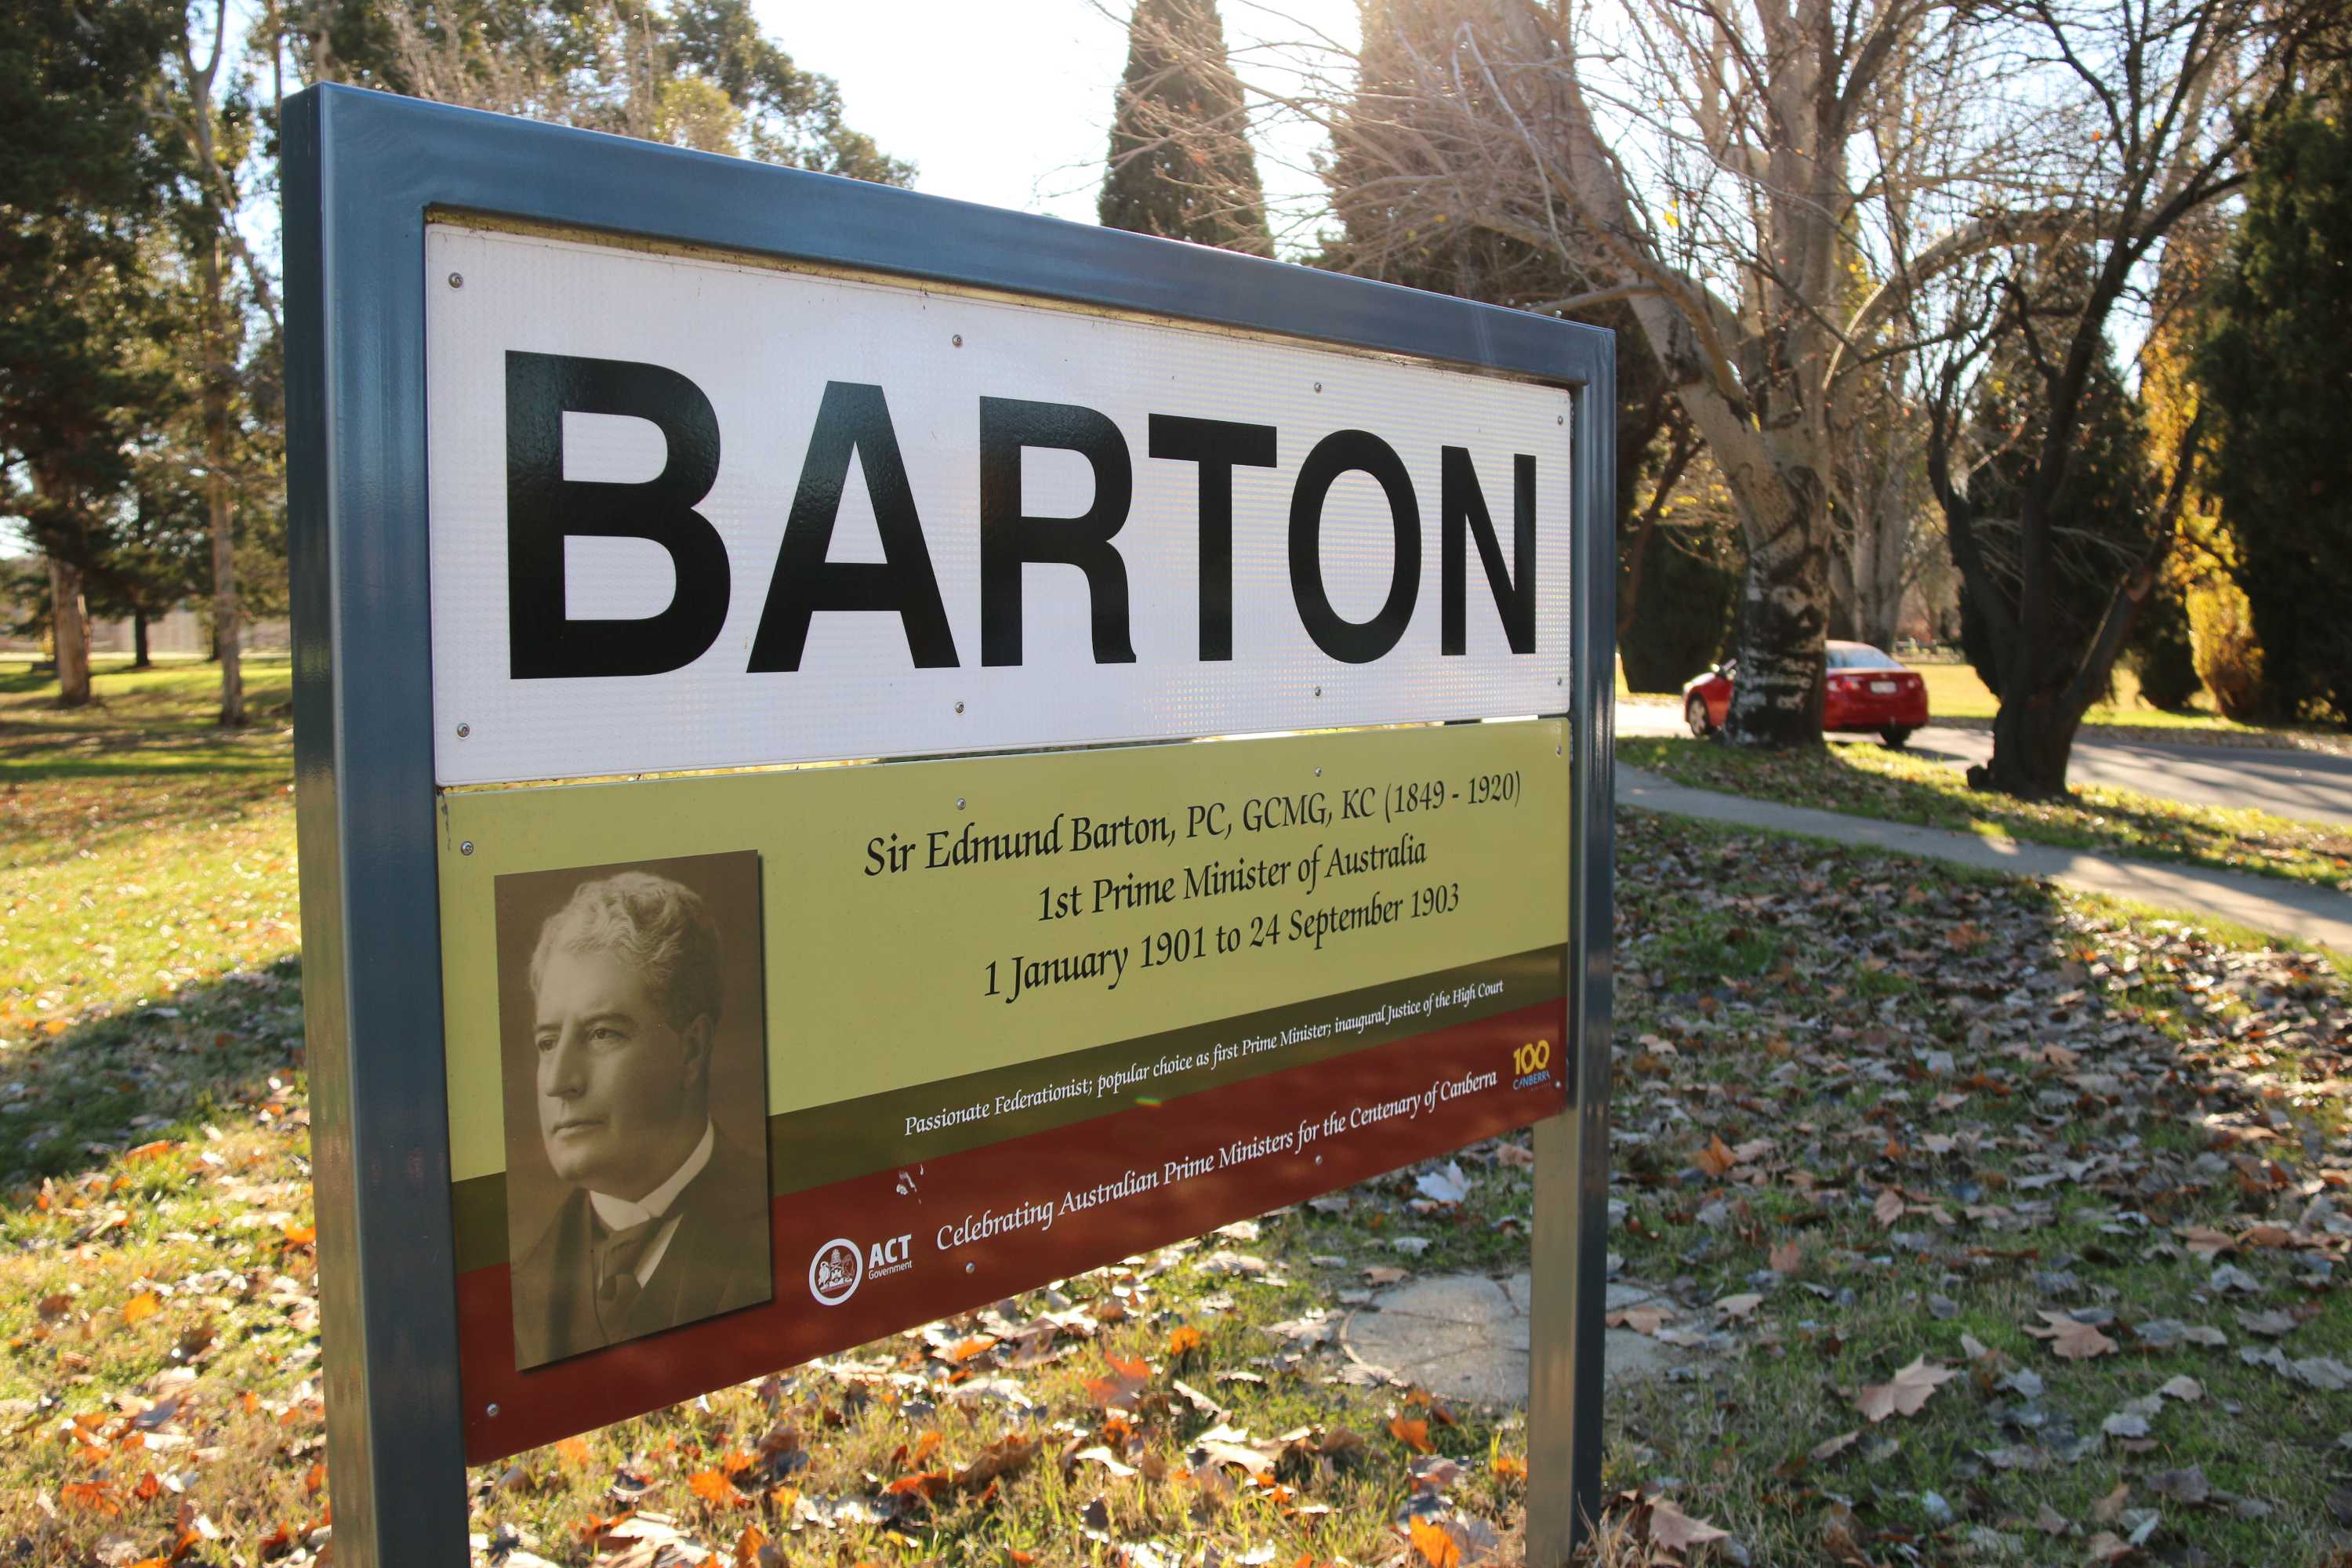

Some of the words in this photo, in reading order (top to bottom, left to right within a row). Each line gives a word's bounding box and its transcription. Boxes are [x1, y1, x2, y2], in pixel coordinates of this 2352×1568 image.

[505, 350, 1537, 680] BARTON
[864, 833, 916, 877] Sir
[925, 813, 1066, 869] Edmund
[1070, 815, 1176, 852] Barton,
[1186, 802, 1232, 841] PC,
[1243, 793, 1333, 833] GCMG,
[1341, 786, 1376, 820] KC
[1385, 782, 1445, 823] (1849
[1467, 771, 1521, 808] 1920)
[1038, 884, 1083, 921] 1st
[1092, 872, 1176, 913] Prime
[1183, 857, 1291, 900] Minister
[1298, 844, 1323, 895] of
[1323, 832, 1428, 878] Australia
[985, 960, 1000, 997] 1
[1005, 946, 1129, 1004] January
[1140, 927, 1207, 968] 1901
[1216, 925, 1241, 954] to
[1249, 913, 1281, 948] 24
[1288, 891, 1403, 950] September
[1410, 883, 1460, 919] 1903
[904, 1102, 990, 1136] Passionate
[994, 1080, 1093, 1116] Federationist;
[1097, 1062, 1150, 1098] popular
[1152, 1056, 1193, 1077] choice
[1196, 1051, 1210, 1067] as
[1210, 1044, 1240, 1070] first
[1242, 1034, 1277, 1056] Prime
[1280, 1022, 1332, 1047] Minister;
[1334, 1005, 1386, 1035] inaugural
[1386, 1000, 1421, 1025] Justice
[1422, 993, 1436, 1017] of
[1436, 992, 1450, 1008] the
[1452, 985, 1476, 1007] High
[1478, 979, 1504, 998] Court
[1513, 1040, 1550, 1075] 100
[937, 1201, 1054, 1250] Celebrating
[1058, 1169, 1159, 1216] Australian
[1163, 1148, 1215, 1185] Prime
[1218, 1131, 1294, 1168] Ministers
[1295, 1120, 1320, 1154] for
[1323, 1111, 1346, 1138] the
[1350, 1094, 1421, 1129] Centenary
[1424, 1081, 1440, 1113] of
[1440, 1069, 1498, 1101] Canberra
[868, 1233, 912, 1269] ACT
[868, 1260, 913, 1280] Government
